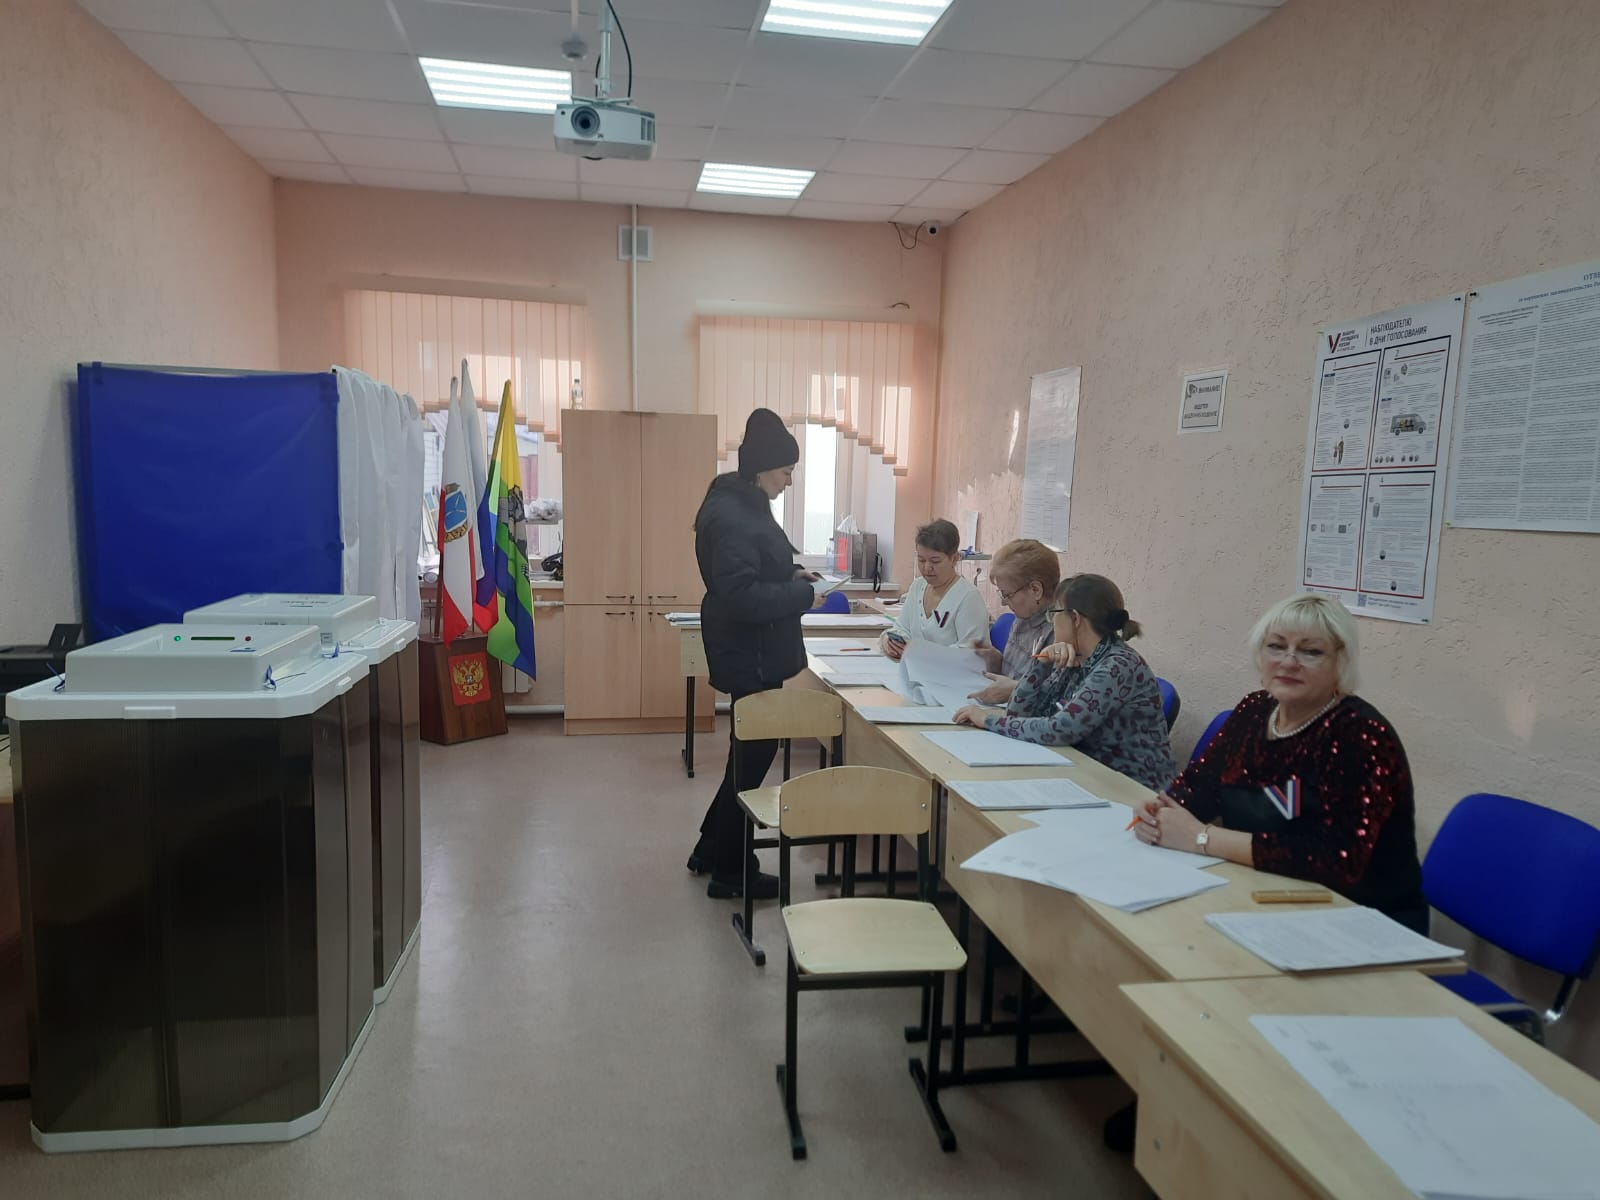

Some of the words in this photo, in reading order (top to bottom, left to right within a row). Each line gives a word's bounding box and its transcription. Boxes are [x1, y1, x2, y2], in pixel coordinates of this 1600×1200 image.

[1370, 317, 1412, 335] НАБЛЮДАТЕЛЮ
[1374, 335, 1386, 345] ДНИ
[1386, 326, 1428, 342] ГОЛОСОВАНИЯ
